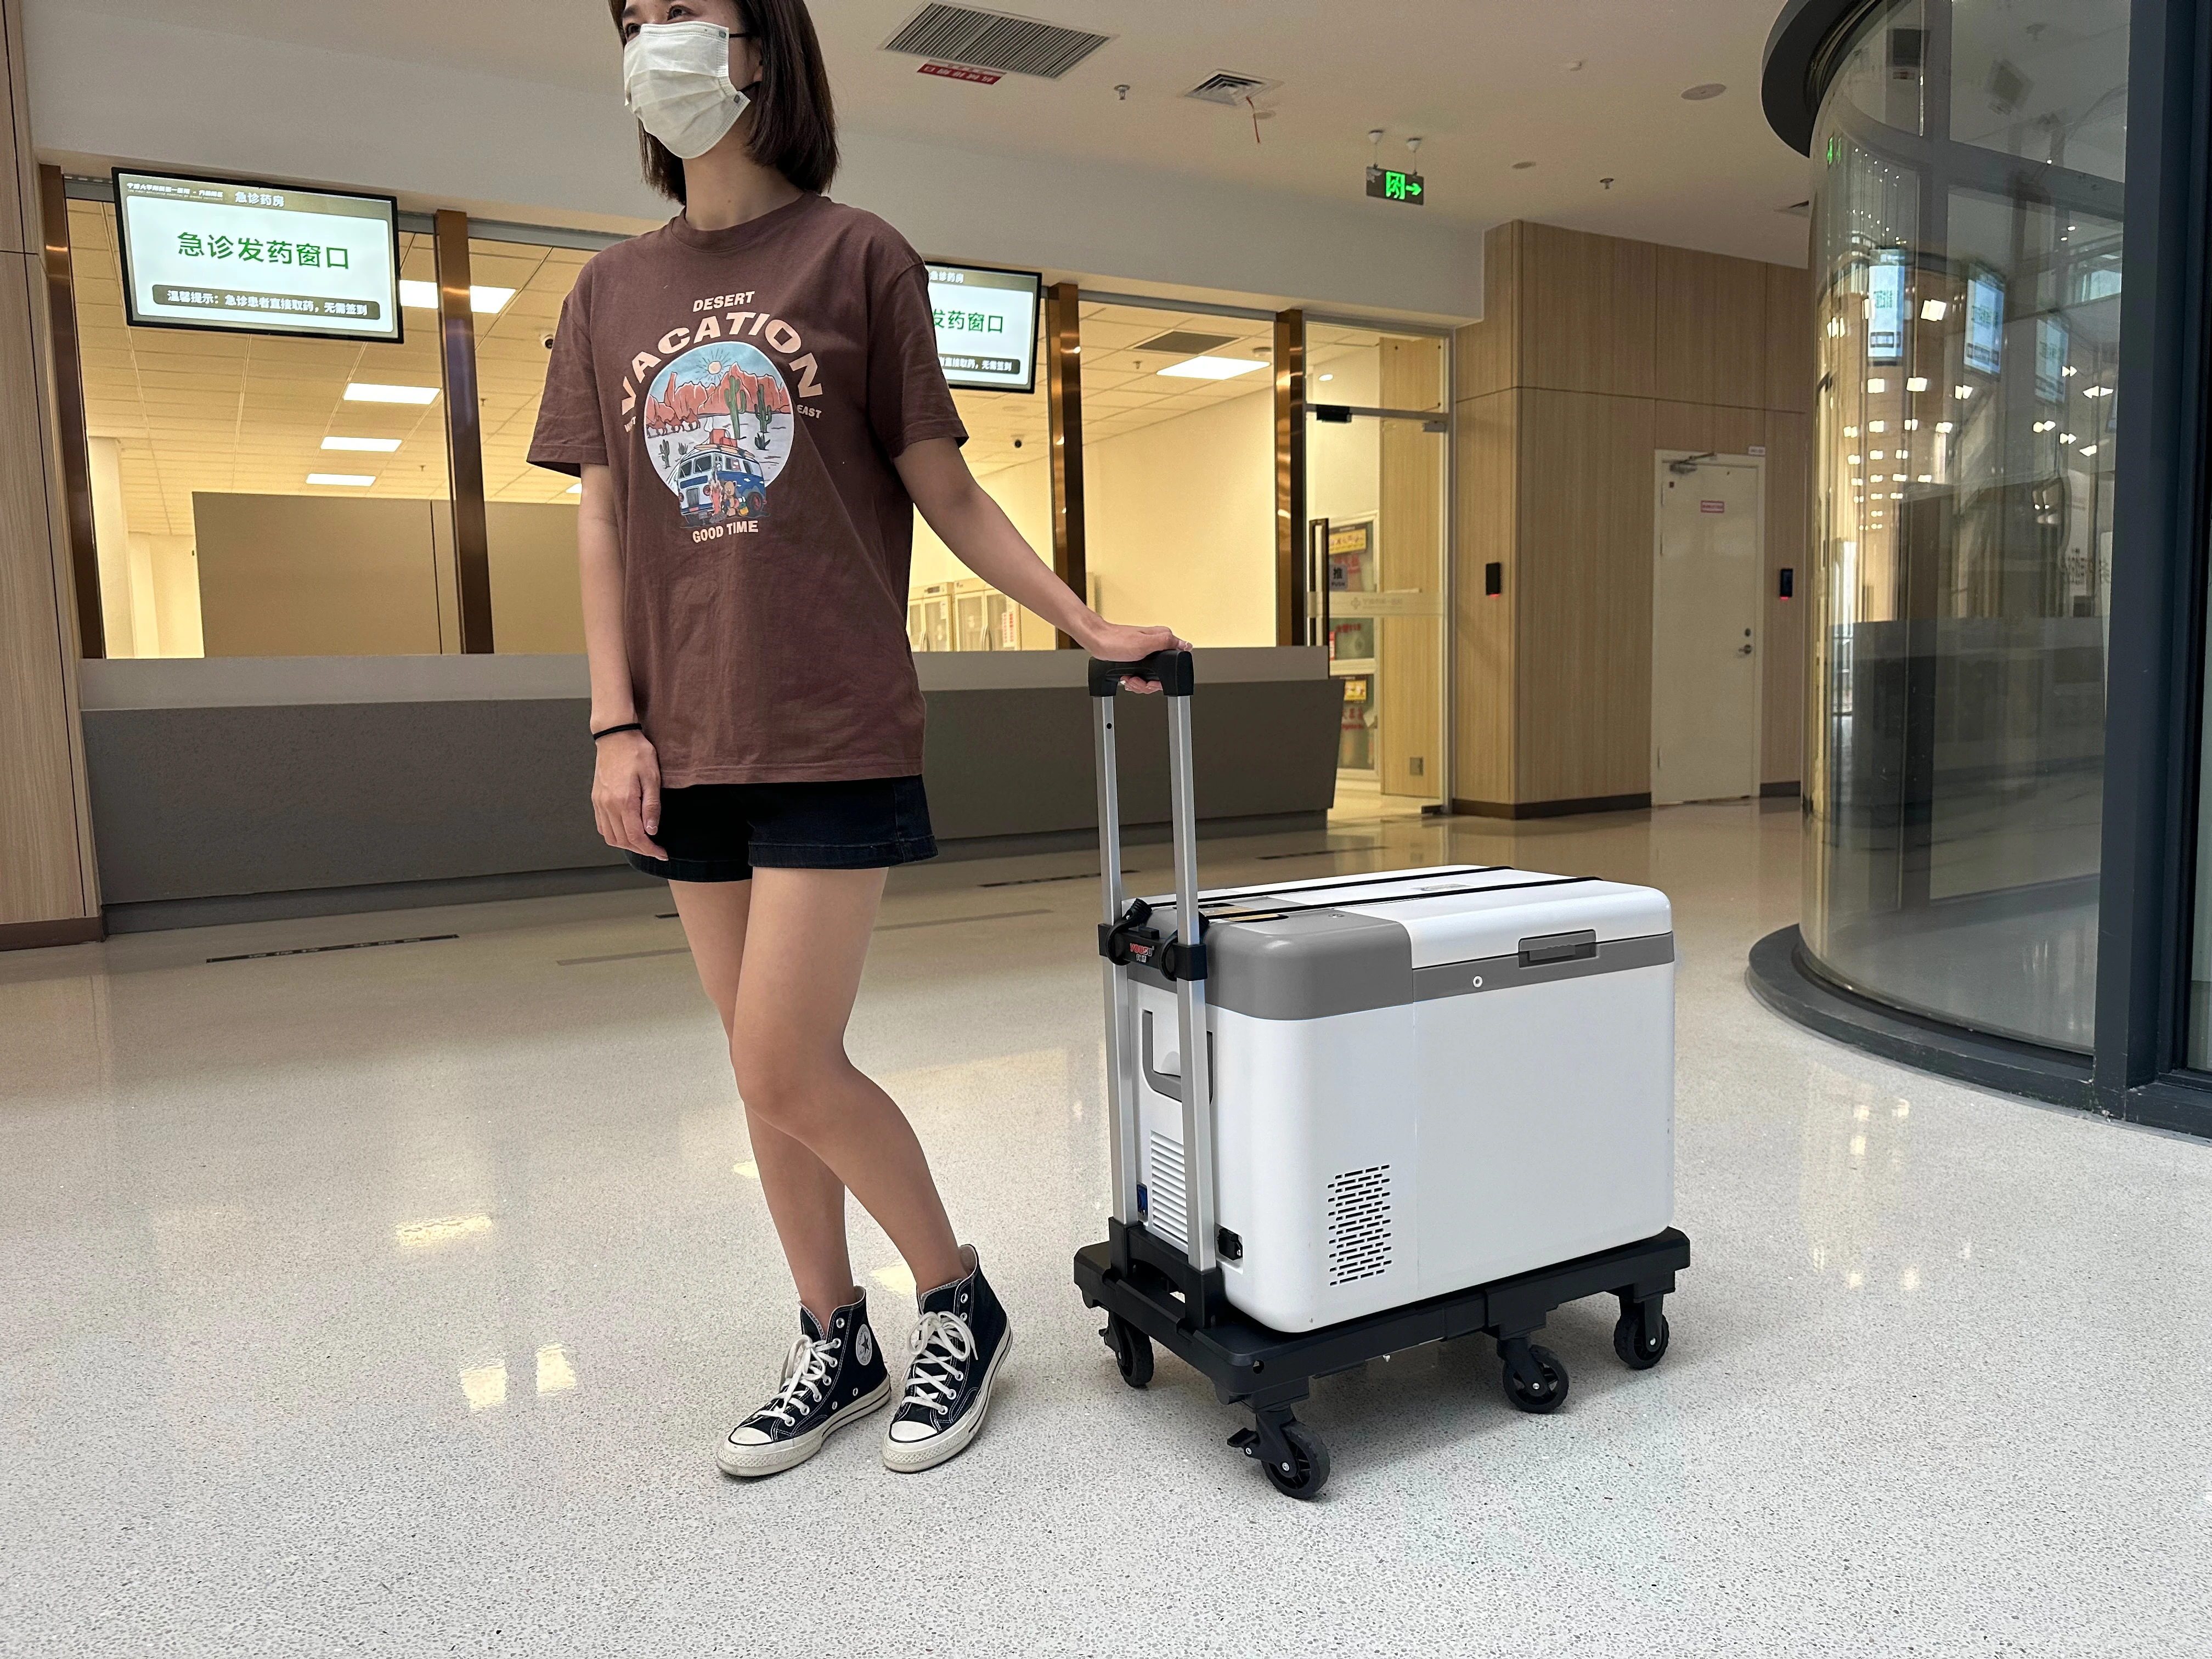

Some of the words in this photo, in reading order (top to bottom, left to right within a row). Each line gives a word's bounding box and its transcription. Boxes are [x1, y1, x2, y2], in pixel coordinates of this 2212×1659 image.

[234, 190, 285, 208] 急诊药房
[177, 232, 349, 270] 急诊发药窗口
[692, 291, 755, 312] DESERT
[933, 308, 1003, 334] 发药窗口
[621, 311, 823, 416] VACATION
[797, 404, 822, 420] EAST
[692, 526, 724, 544] GOOD
[726, 520, 759, 535] TIME
